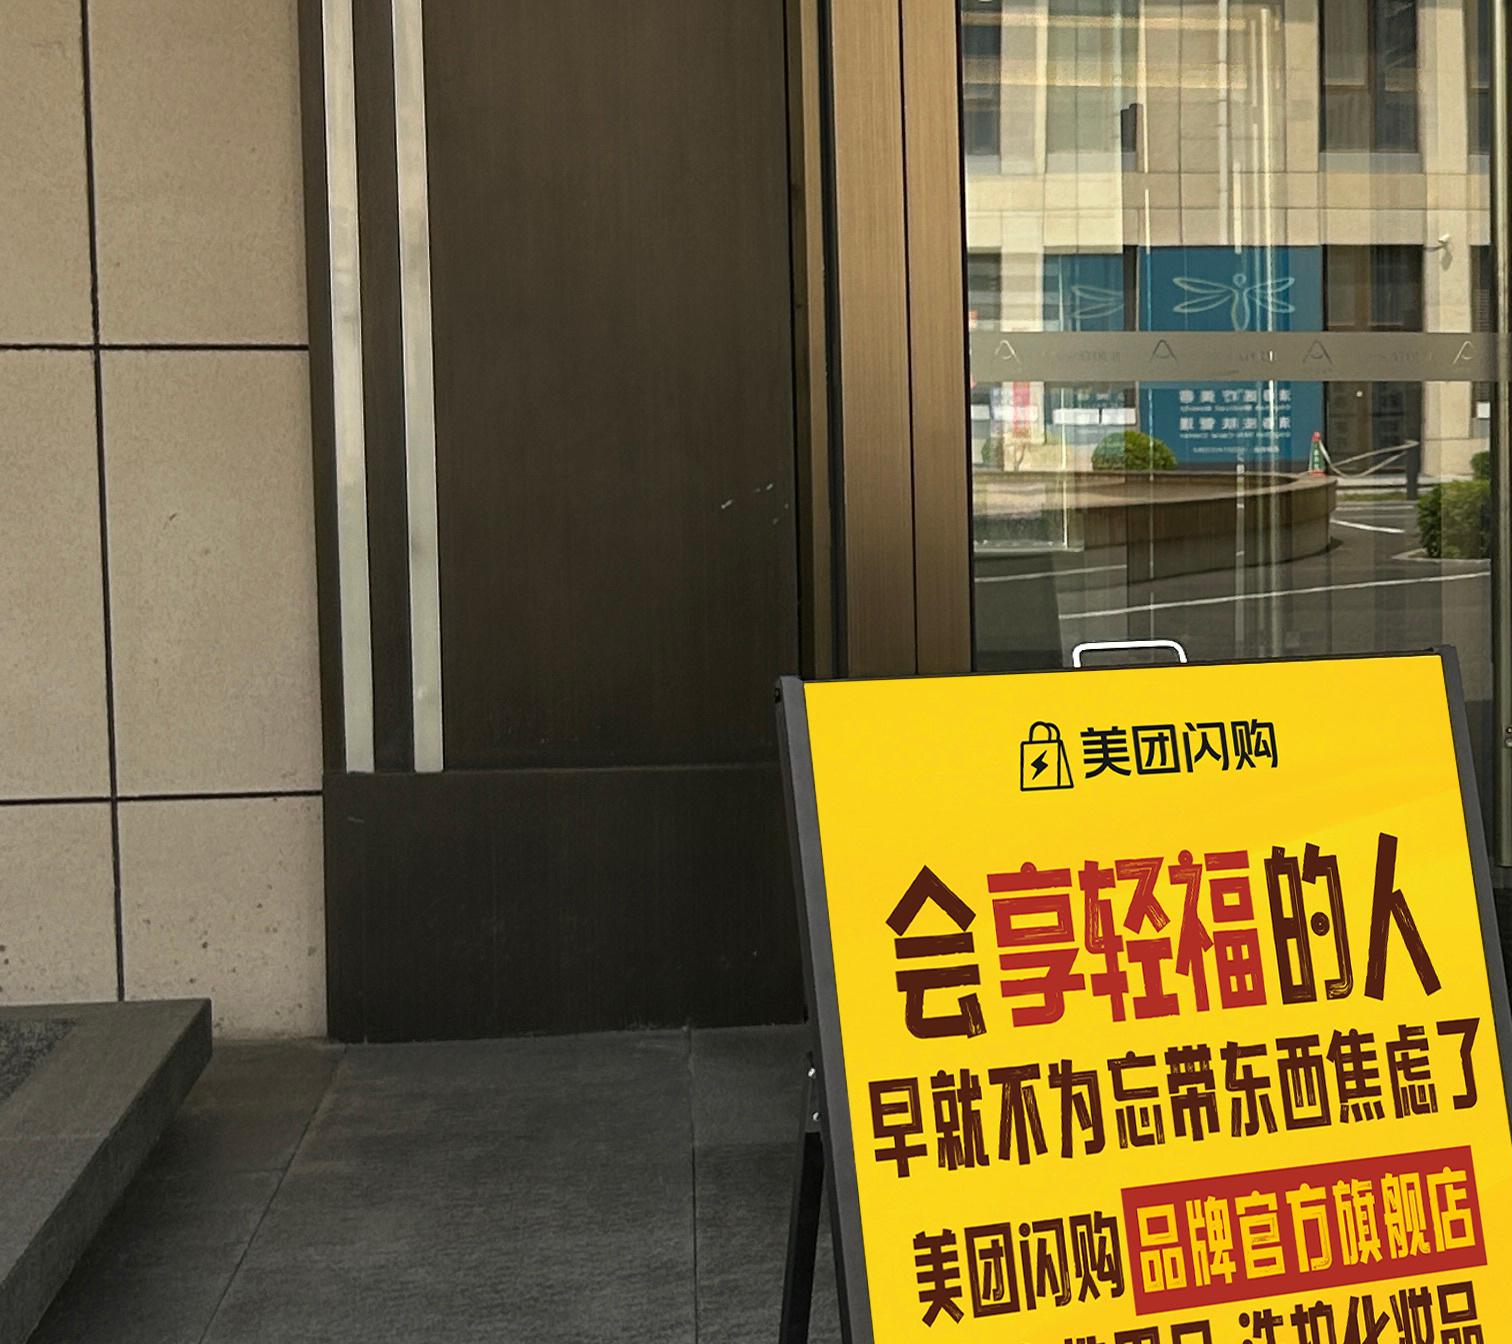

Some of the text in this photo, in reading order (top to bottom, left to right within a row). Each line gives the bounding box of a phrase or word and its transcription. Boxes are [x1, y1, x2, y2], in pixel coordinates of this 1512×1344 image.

[1080, 719, 1278, 779] 美团闪购
[885, 832, 1442, 1040] 会享轻福的人
[868, 1017, 1480, 1179] 早就不为忘带东西焦虑了
[912, 1166, 1476, 1327] 美团闪购 品牌官方旗舰店
